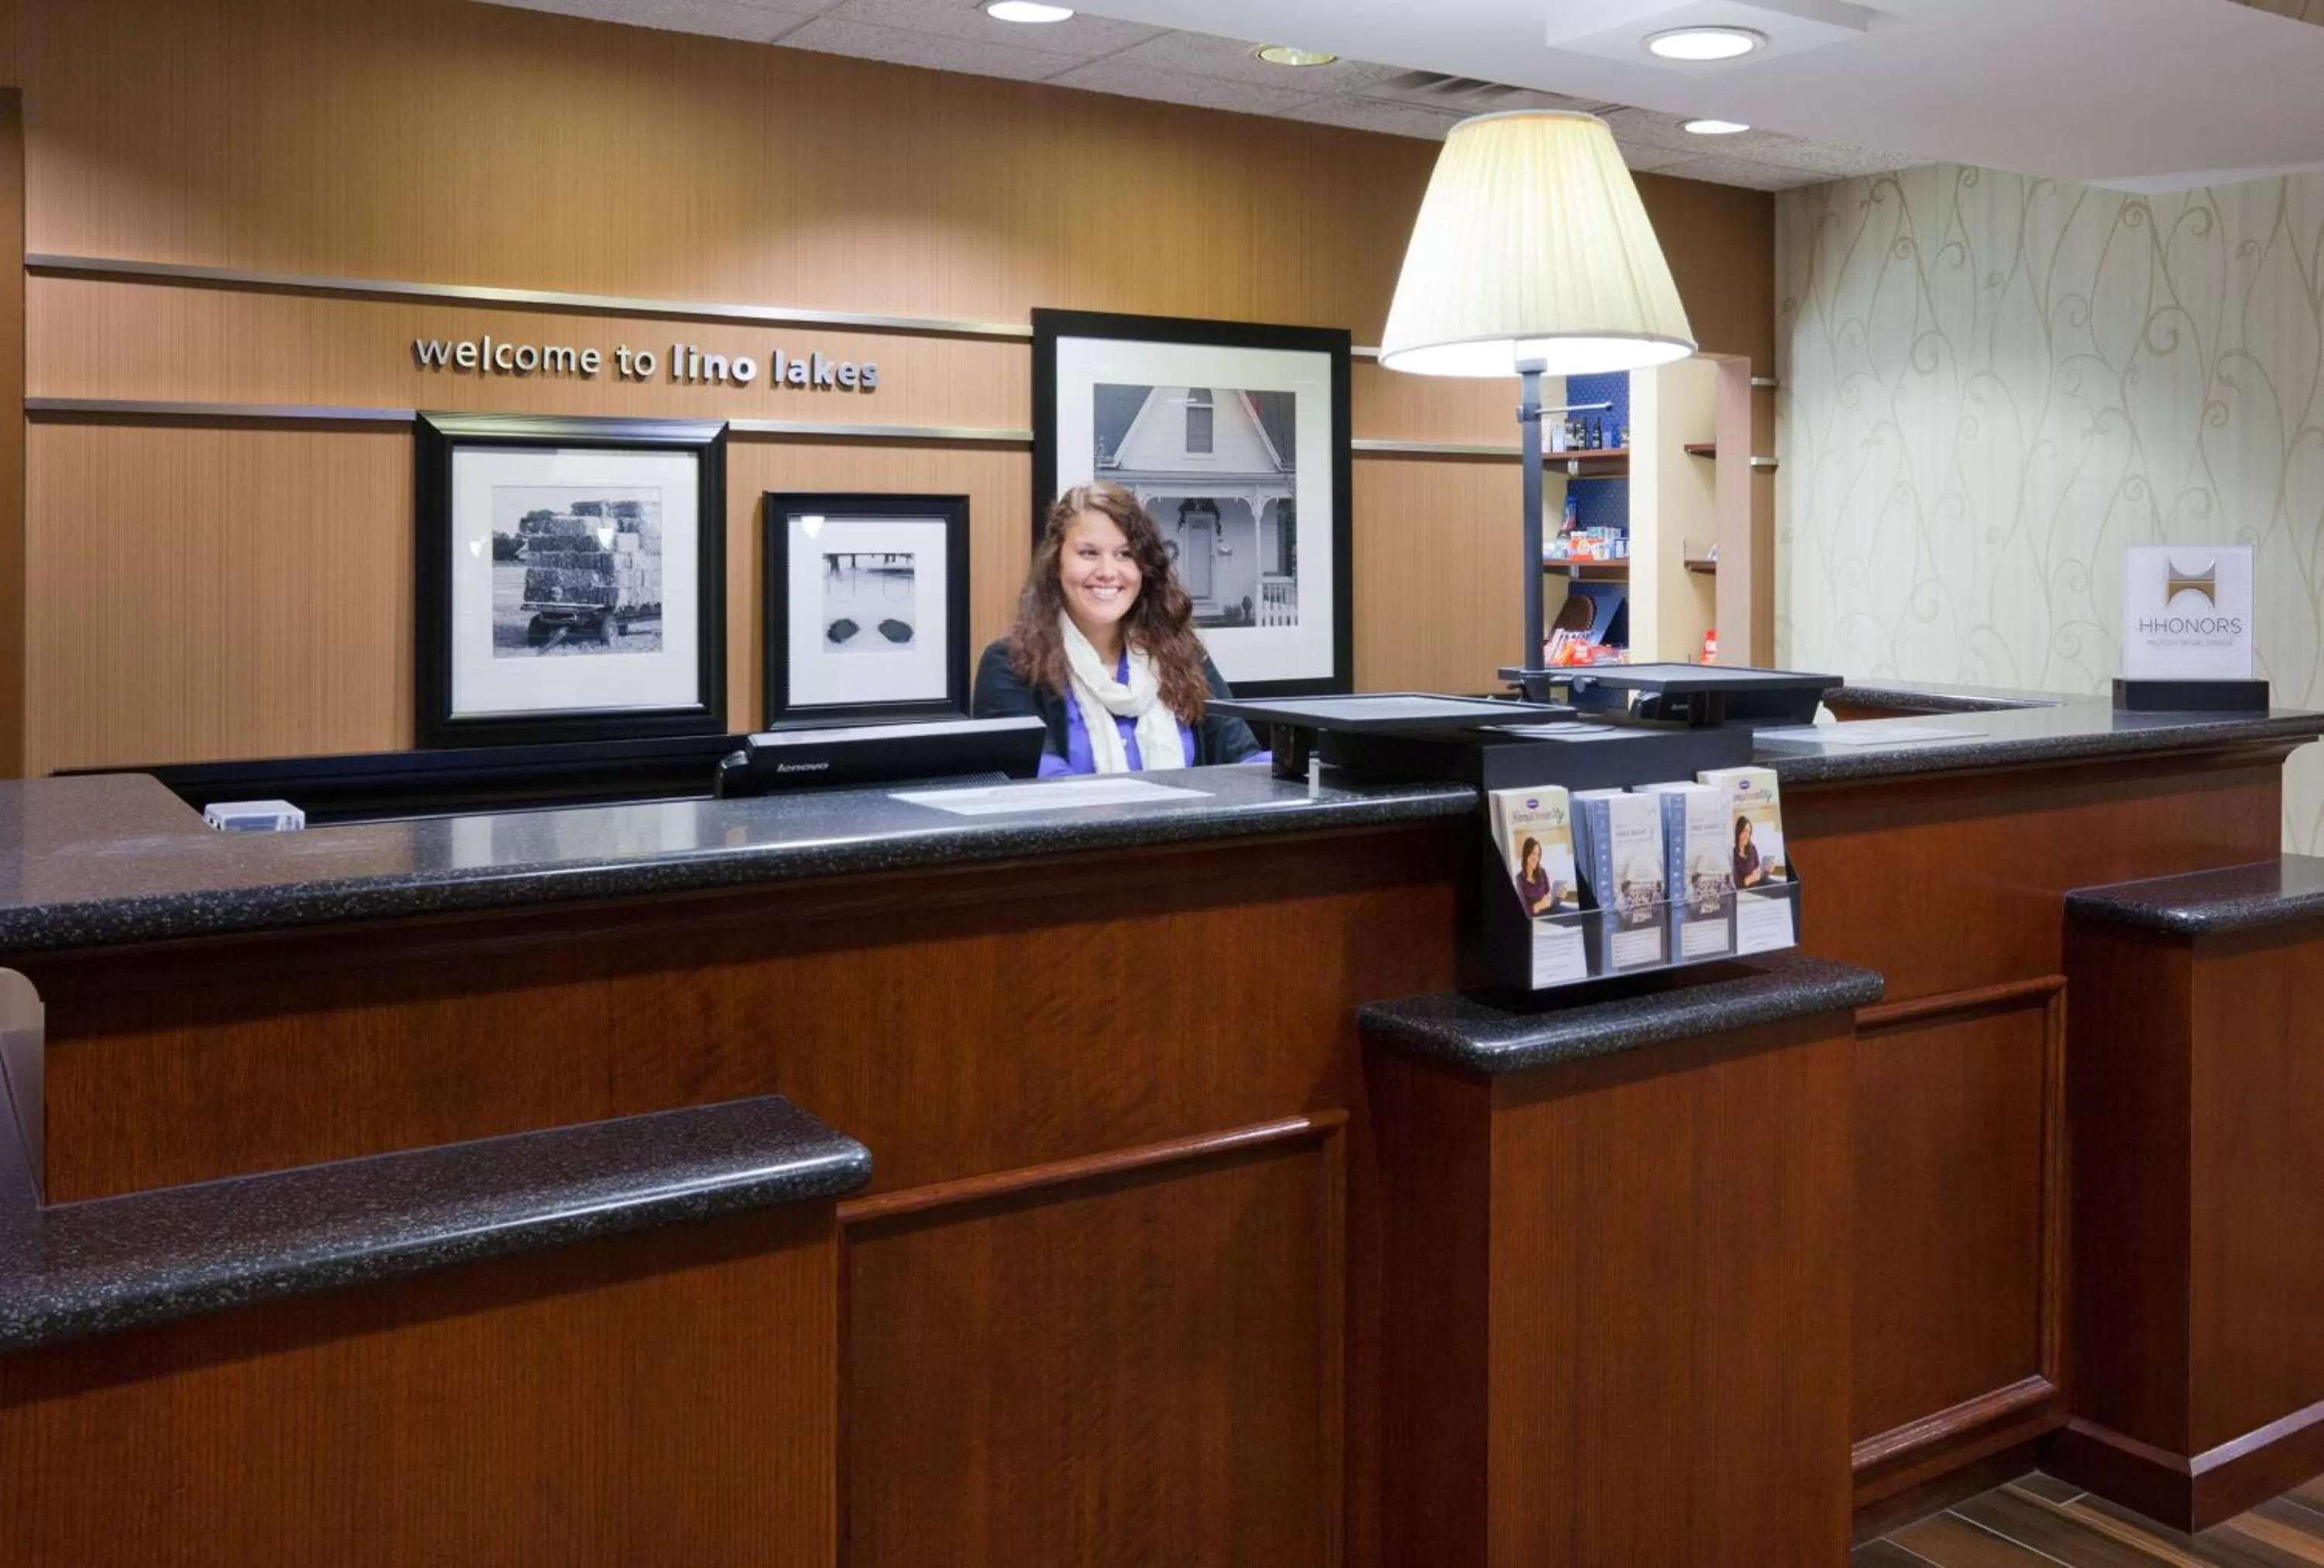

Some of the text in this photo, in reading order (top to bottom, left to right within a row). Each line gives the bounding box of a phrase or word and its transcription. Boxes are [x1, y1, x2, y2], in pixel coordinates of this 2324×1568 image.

[414, 334, 878, 387] welcome to lino lakes
[2138, 617, 2243, 634] HHONORS
[776, 762, 829, 773] lenovo
